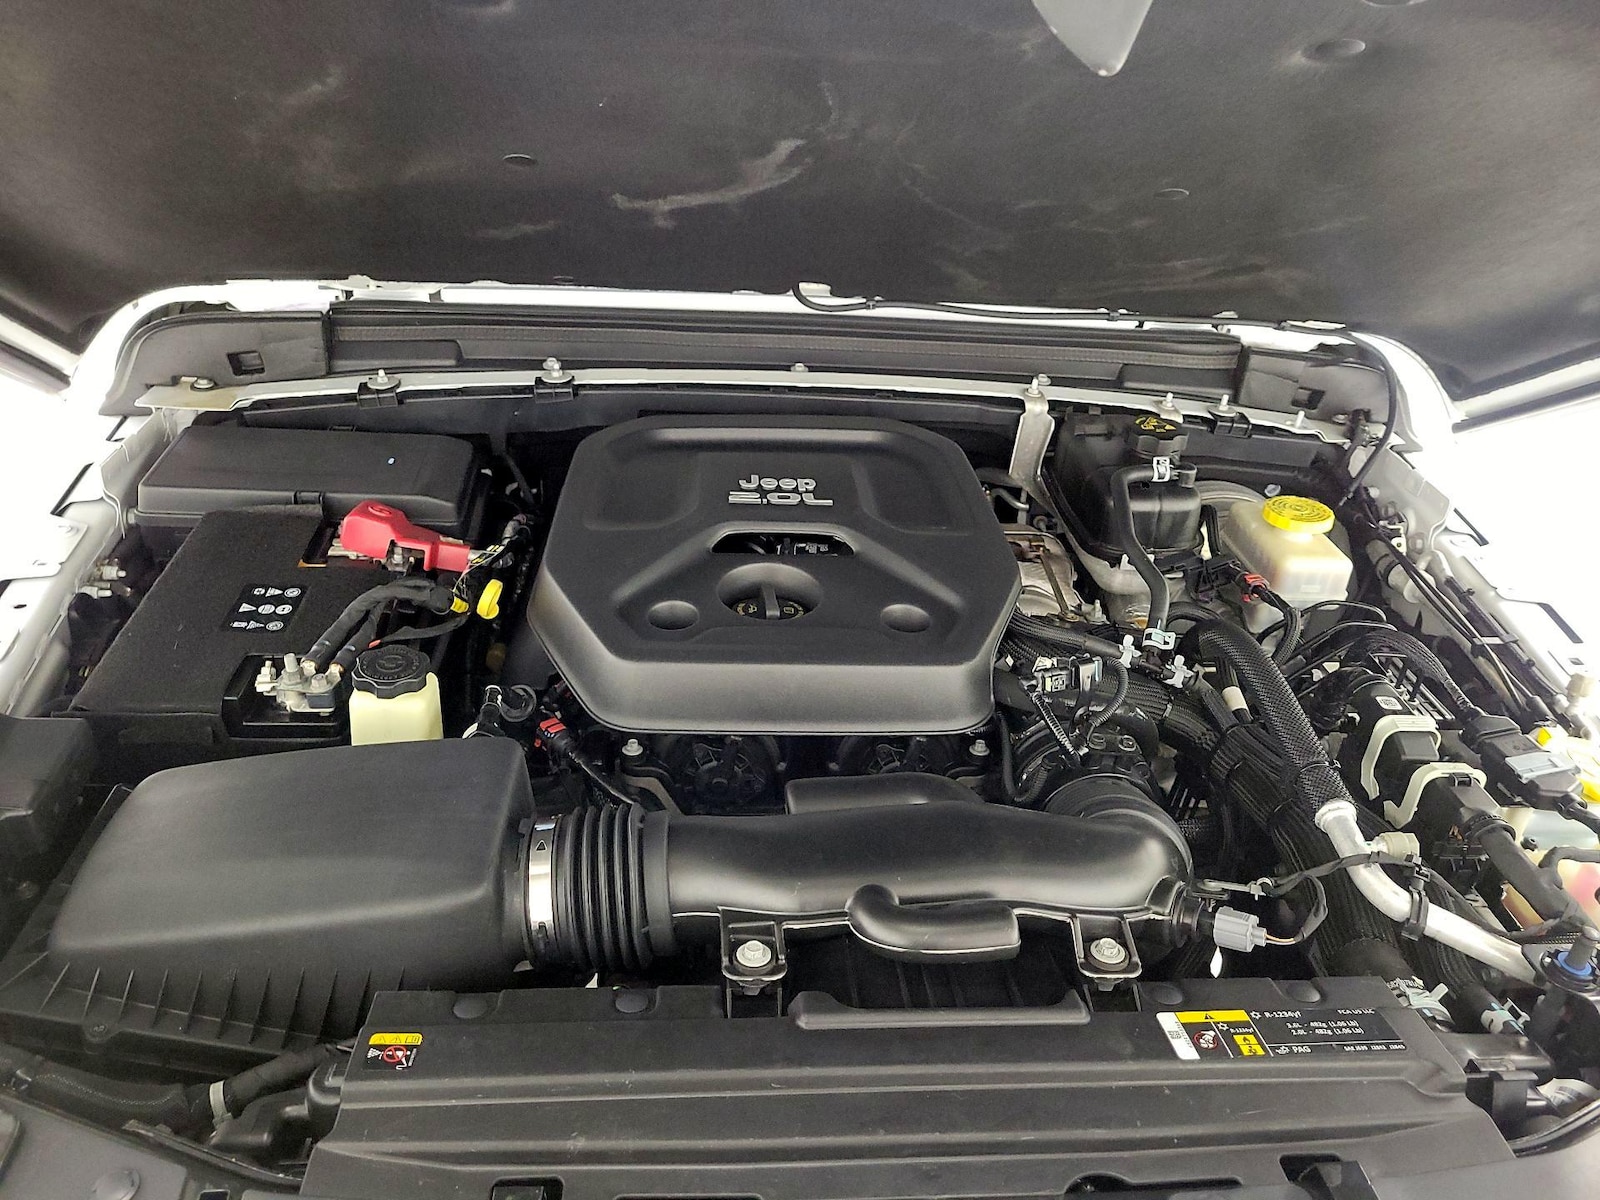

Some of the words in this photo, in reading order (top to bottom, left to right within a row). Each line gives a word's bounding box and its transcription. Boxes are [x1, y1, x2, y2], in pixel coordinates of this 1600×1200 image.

[738, 474, 817, 492] Jeep
[728, 491, 834, 506] 2.0L
[1263, 1010, 1302, 1018] R-1234yf
[1292, 1045, 1312, 1053] PAG
